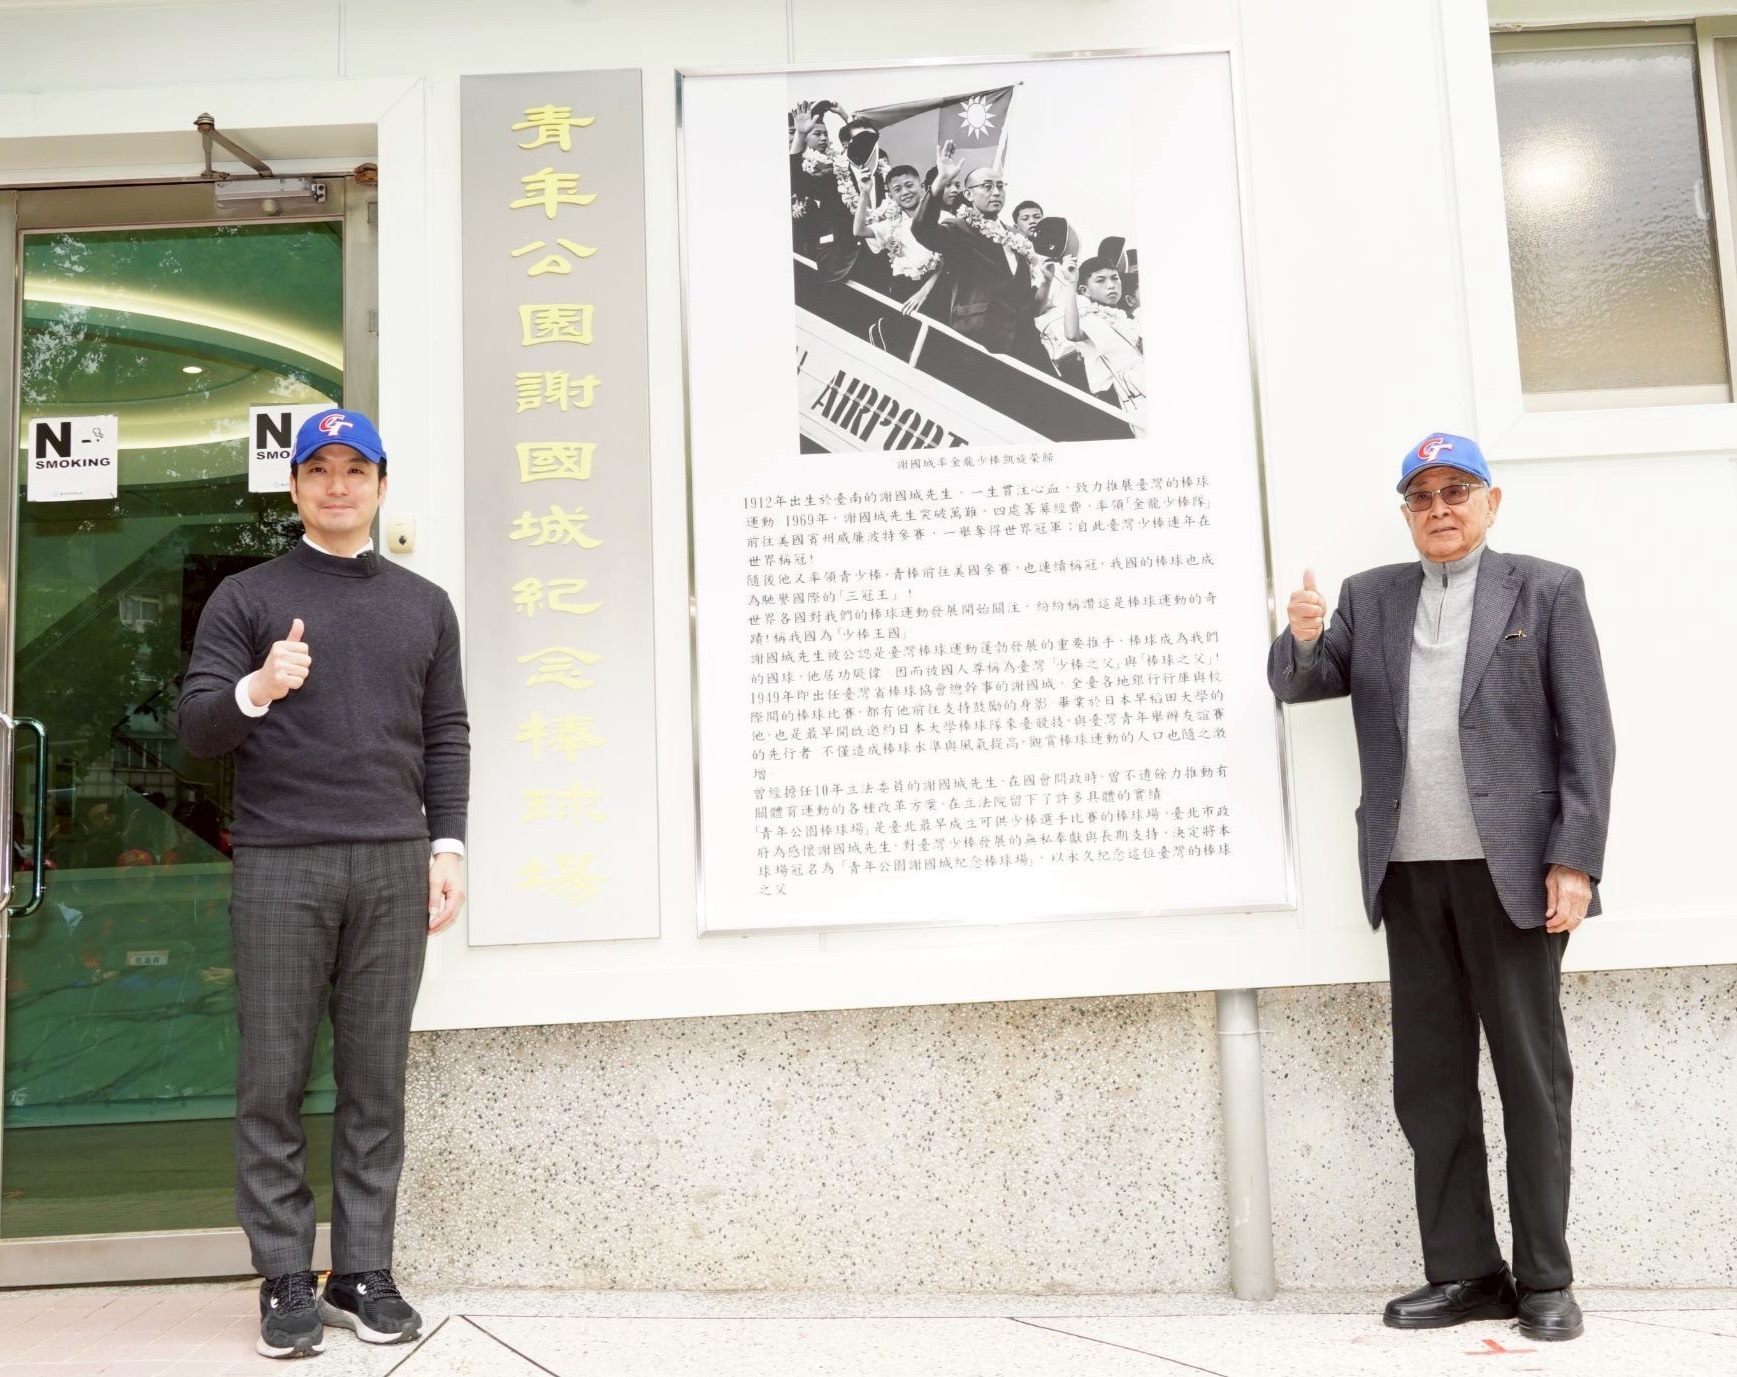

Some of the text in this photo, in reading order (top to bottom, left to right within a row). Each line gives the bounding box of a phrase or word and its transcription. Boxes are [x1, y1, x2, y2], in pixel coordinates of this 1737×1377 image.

[256, 450, 291, 460] SMO
[35, 457, 111, 470] SMOKING
[508, 103, 608, 908] 青年公園謝國城紀念棒球場
